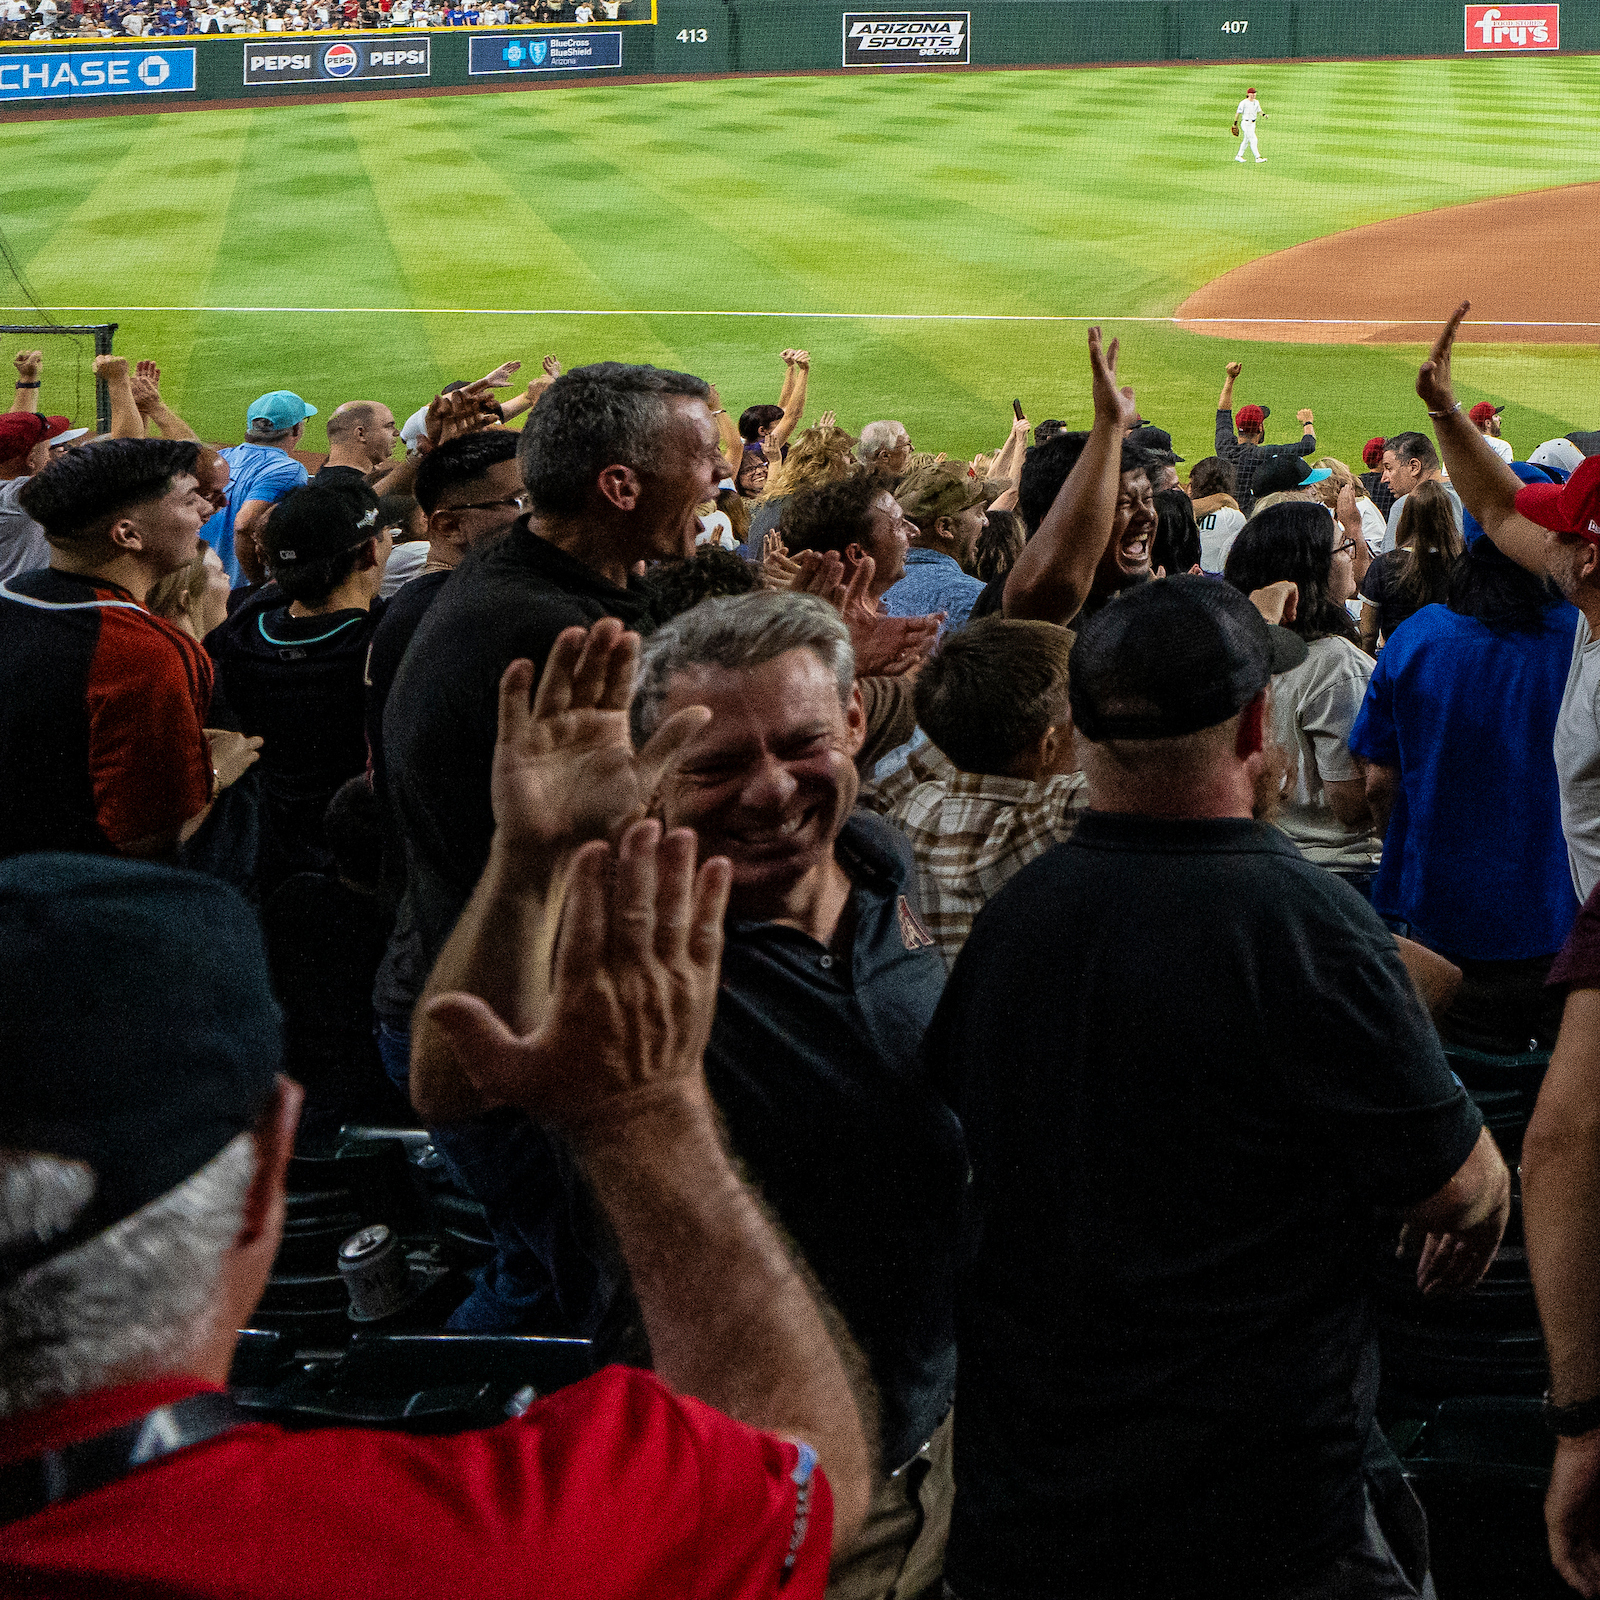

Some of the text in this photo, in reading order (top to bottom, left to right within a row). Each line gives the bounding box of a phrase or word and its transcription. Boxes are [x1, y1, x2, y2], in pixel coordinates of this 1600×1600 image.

[856, 22, 952, 36] ARIZONA
[1220, 20, 1249, 34] 407
[1474, 7, 1550, 45] fry's
[676, 29, 708, 43] 413
[866, 35, 956, 49] SPORTS
[550, 38, 590, 49] BlueCross
[370, 49, 425, 67] PEPSI
[550, 48, 592, 58] BlueShield
[251, 54, 311, 72] PEPSI
[327, 57, 354, 66] PEPSI
[551, 57, 577, 66] Arizona
[0, 60, 131, 90] CHASE
